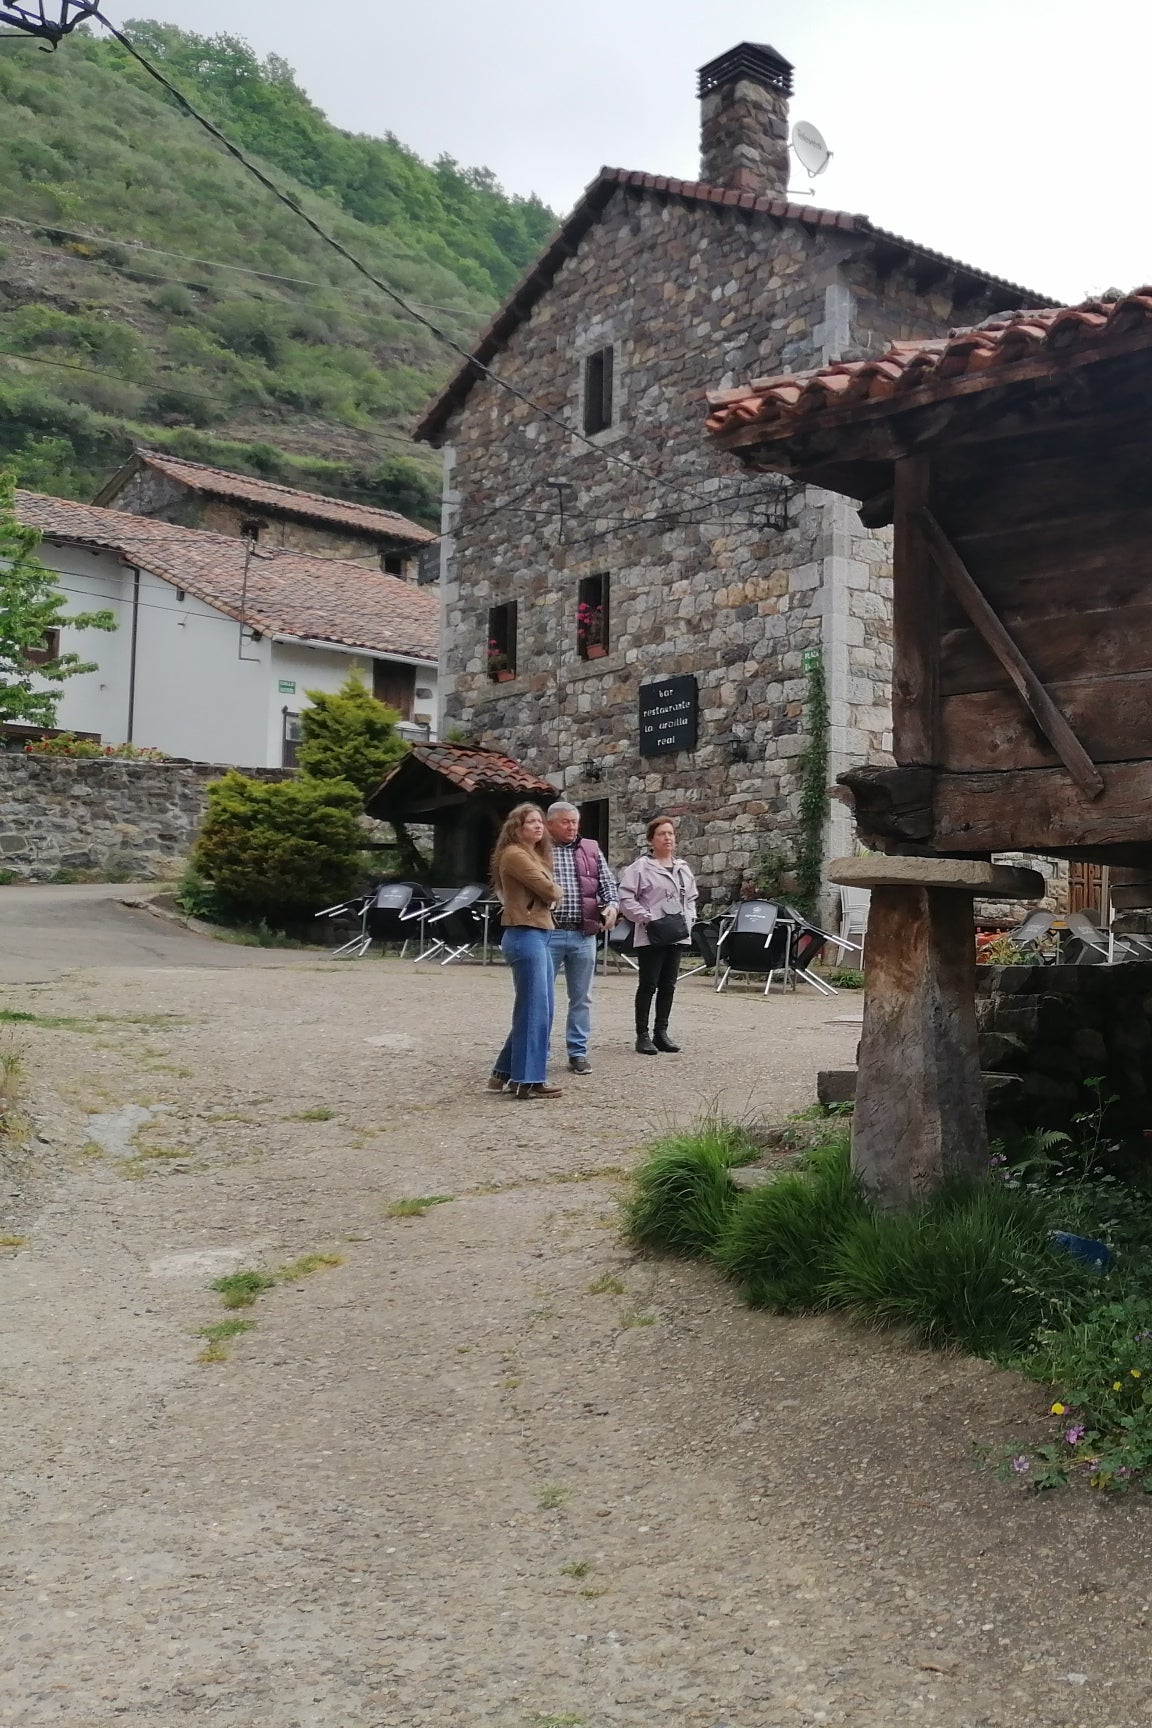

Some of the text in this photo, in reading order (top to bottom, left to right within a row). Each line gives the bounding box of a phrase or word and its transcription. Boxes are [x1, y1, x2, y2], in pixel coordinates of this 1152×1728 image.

[658, 689, 674, 698] bar
[643, 700, 691, 718] restaurante
[644, 724, 654, 733] la
[657, 735, 675, 747] real
